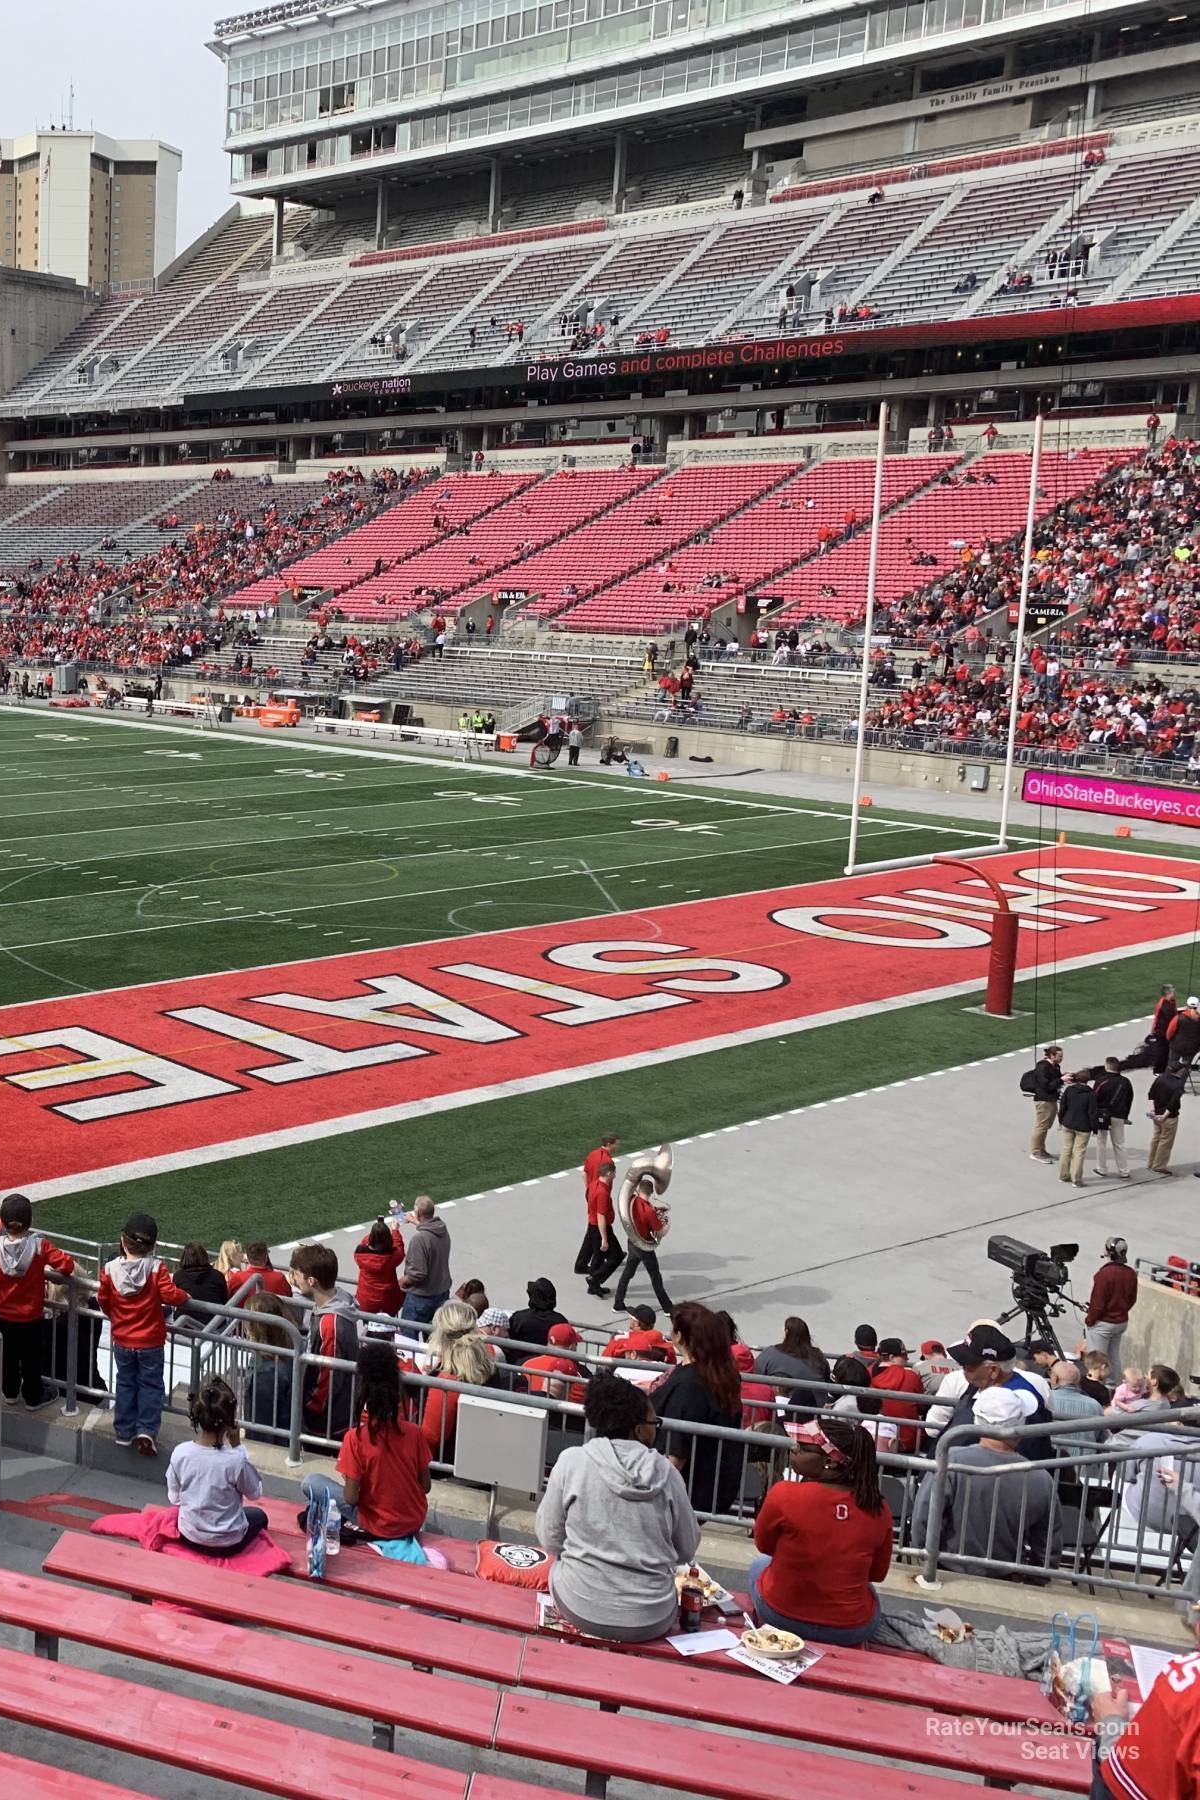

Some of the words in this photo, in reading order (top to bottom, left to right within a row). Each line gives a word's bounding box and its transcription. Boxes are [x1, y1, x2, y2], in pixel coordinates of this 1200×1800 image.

[929, 98, 946, 107] The
[950, 92, 977, 104] Shelly
[982, 84, 1014, 97] Family
[527, 366, 559, 382] Play
[563, 361, 616, 379] Games
[620, 356, 650, 374] and
[656, 350, 735, 372] complete
[740, 338, 844, 363] Challenges
[342, 381, 380, 393] buckeye
[381, 378, 411, 388] nation
[766, 866, 1200, 950] OHIO
